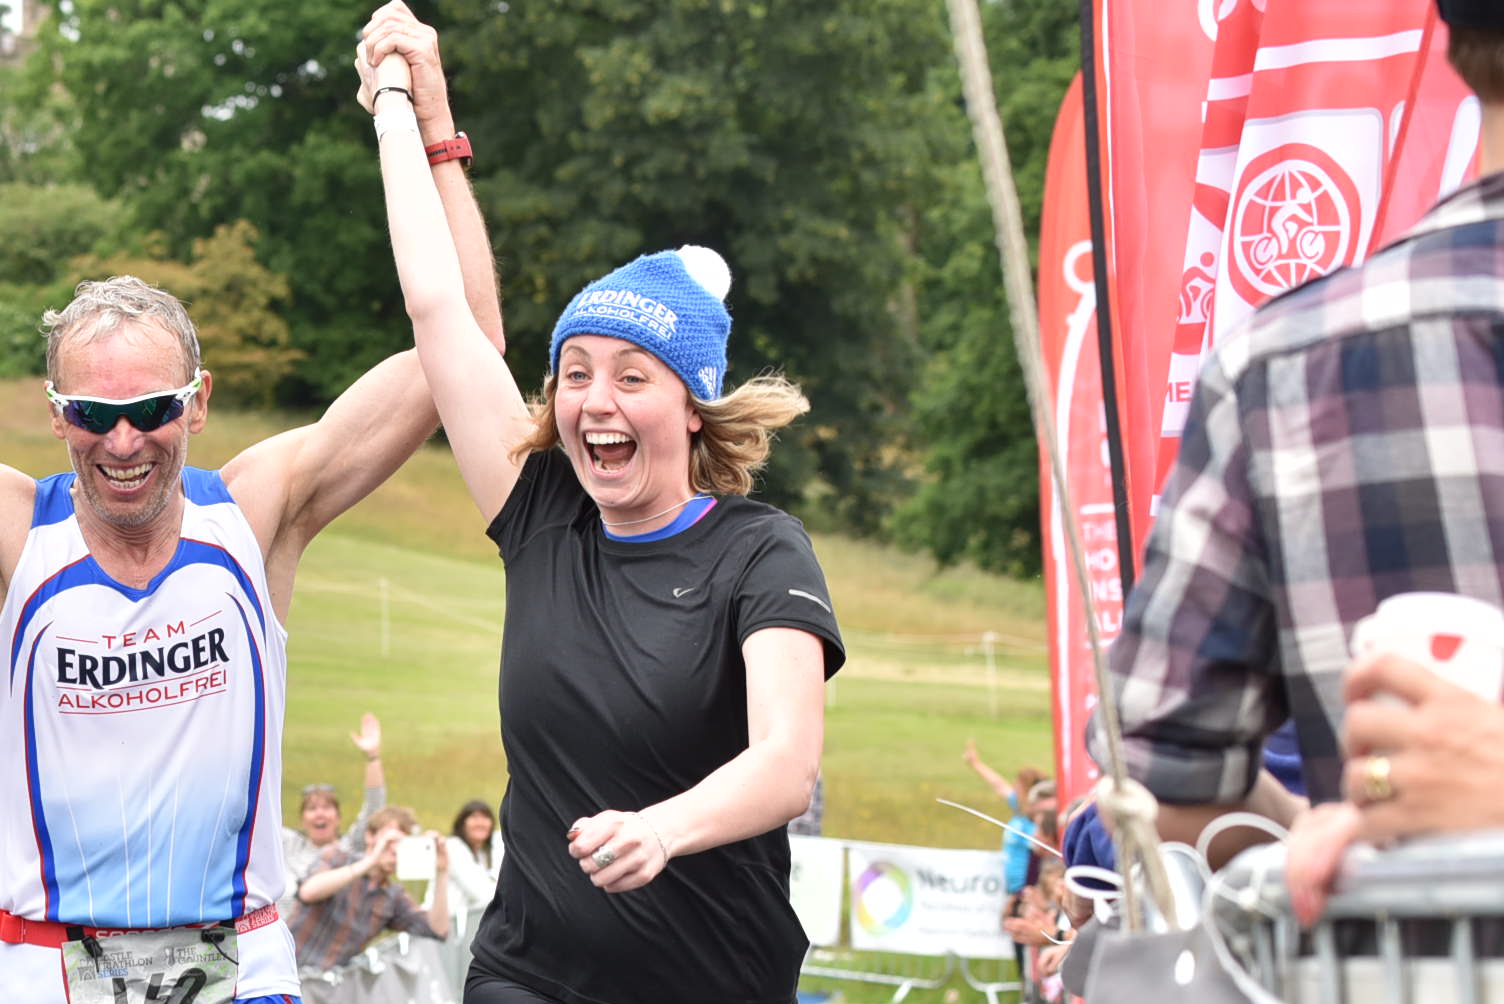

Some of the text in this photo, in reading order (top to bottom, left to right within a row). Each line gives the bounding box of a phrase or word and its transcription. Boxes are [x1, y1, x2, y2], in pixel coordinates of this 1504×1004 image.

[101, 620, 186, 650] TEAM
[56, 627, 231, 690] ERDINGER
[57, 668, 228, 710] ALKOHOLFREI
[101, 951, 133, 961] ASTLE
